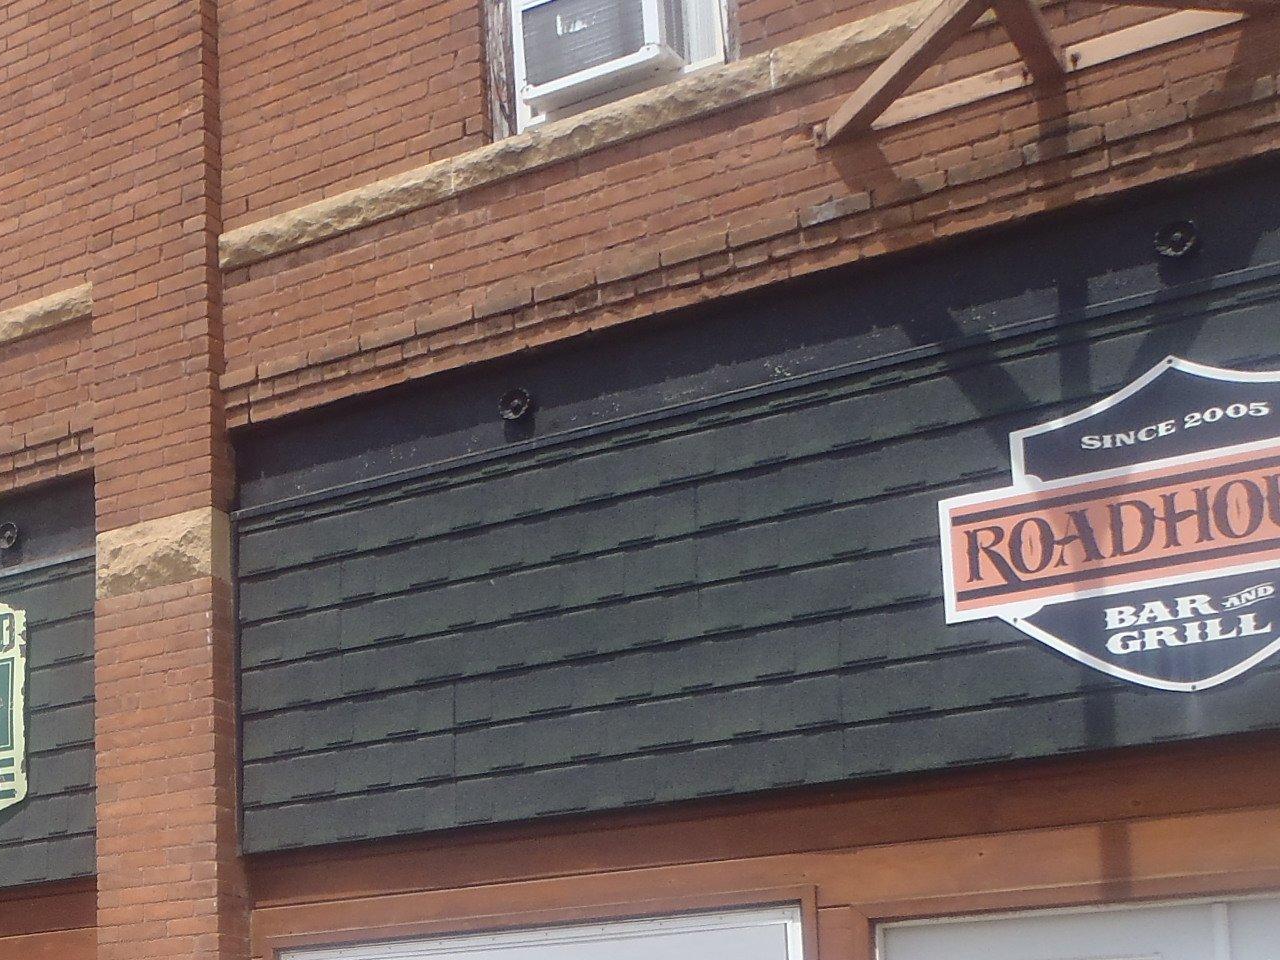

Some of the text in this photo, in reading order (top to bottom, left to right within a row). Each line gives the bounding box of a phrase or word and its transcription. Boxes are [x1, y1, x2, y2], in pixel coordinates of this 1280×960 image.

[1081, 401, 1270, 450] SINCE 2005
[1105, 581, 1275, 631] BAR AND
[1106, 613, 1272, 655] GRILL
